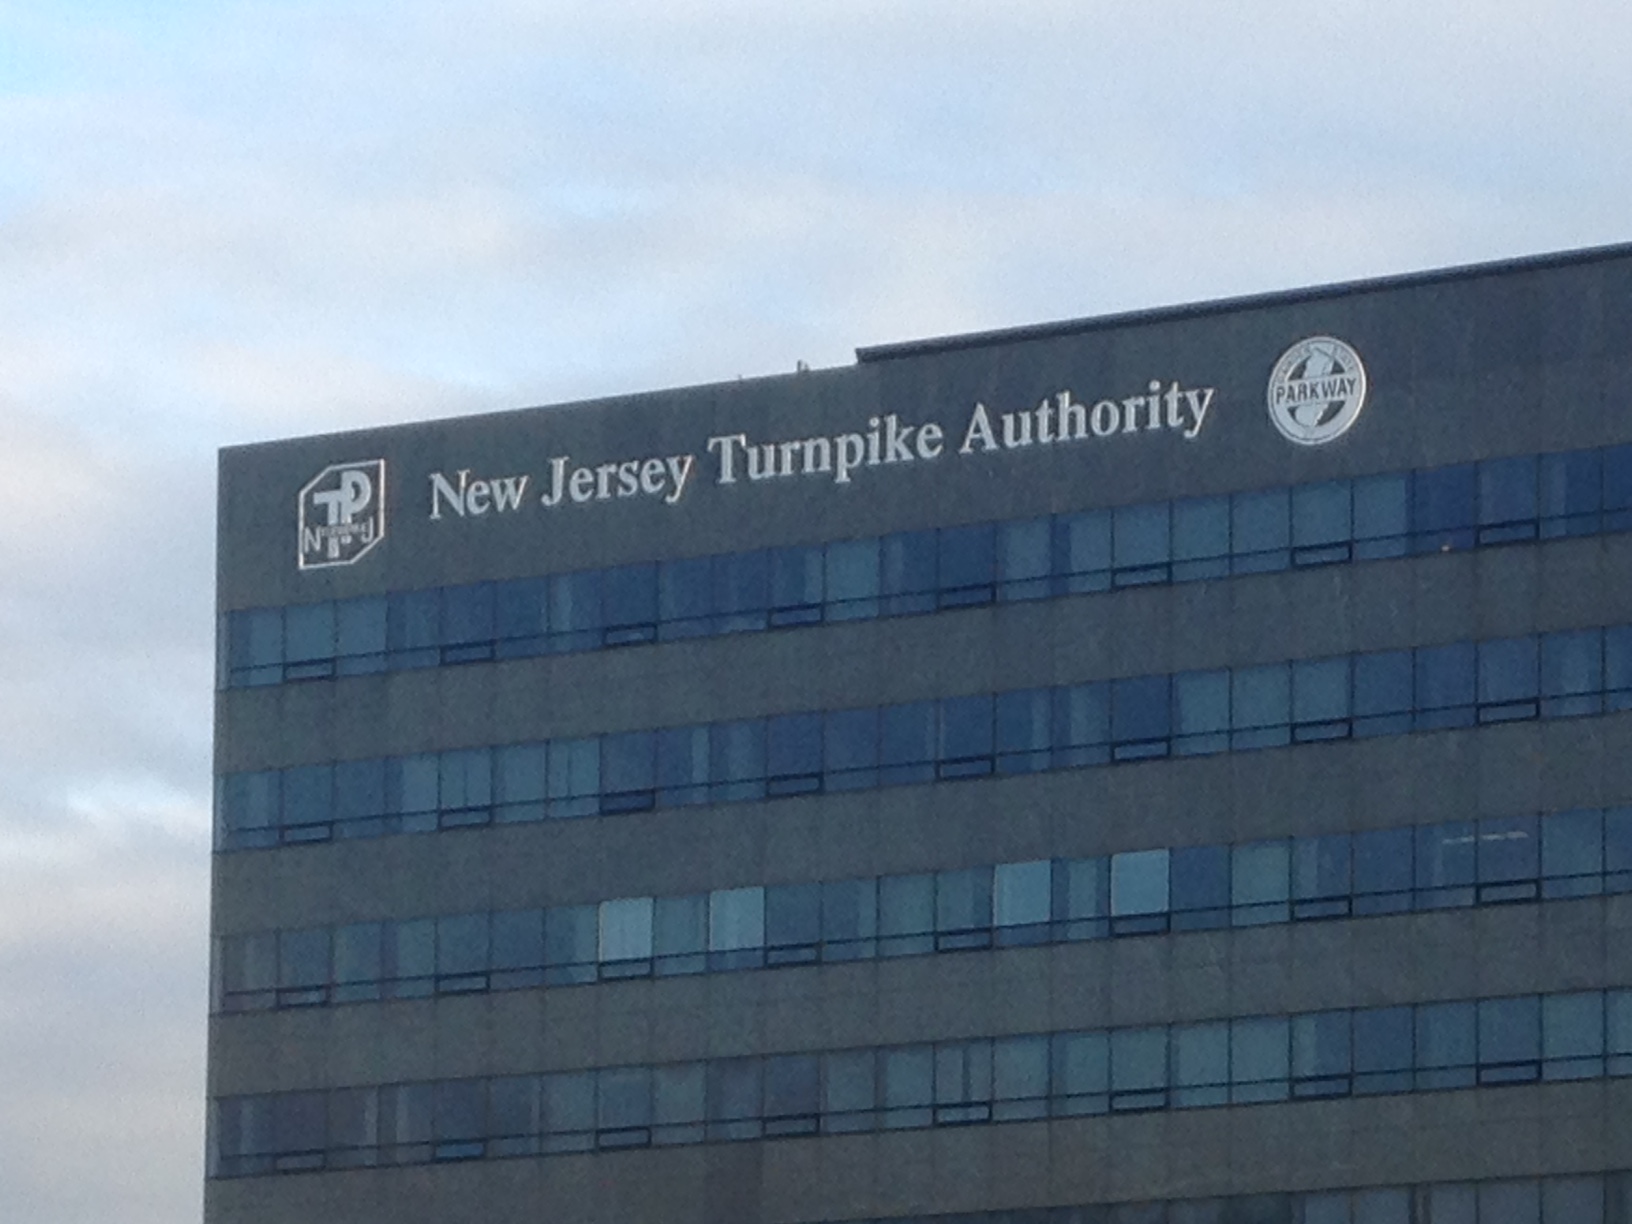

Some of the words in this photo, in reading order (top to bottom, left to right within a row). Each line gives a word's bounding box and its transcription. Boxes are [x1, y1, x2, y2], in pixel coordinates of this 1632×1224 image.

[1276, 377, 1357, 405] PARKWAY
[428, 468, 529, 520] New
[541, 454, 694, 507] Jersey
[707, 412, 944, 484] Turnpike
[958, 379, 1215, 454] Authority
